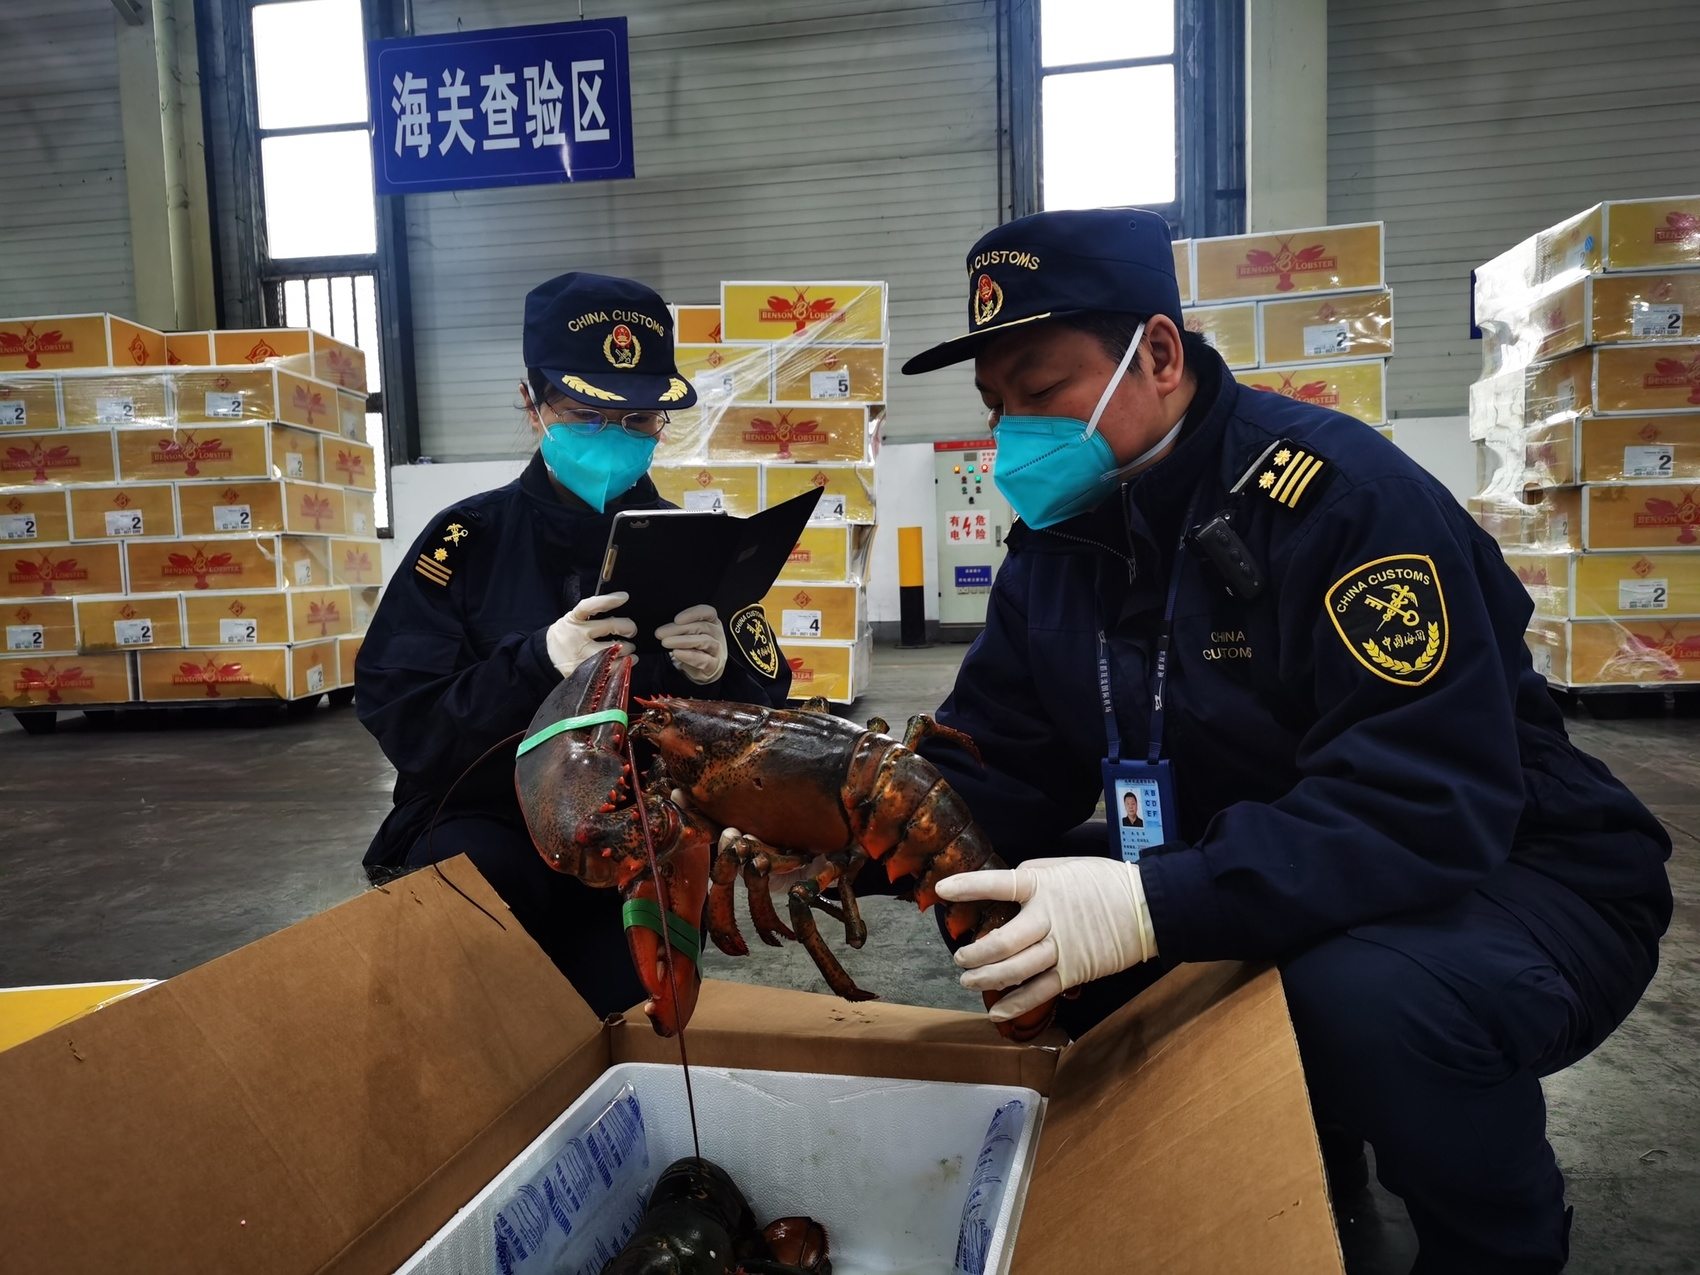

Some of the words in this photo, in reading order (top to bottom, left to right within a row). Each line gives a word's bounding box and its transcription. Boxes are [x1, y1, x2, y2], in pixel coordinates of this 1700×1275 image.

[391, 59, 610, 158] 海关查验区
[975, 251, 1040, 270] CUSTOMS
[1240, 264, 1275, 275] BENSON
[1295, 259, 1334, 270] LOBSTER
[568, 311, 609, 332] CHINA
[612, 310, 665, 337] CUSTOMS
[1668, 313, 1681, 329] 2
[1336, 332, 1347, 347] 2
[723, 378, 733, 392] 5
[838, 379, 848, 393] 5
[123, 405, 133, 417] 2
[232, 401, 241, 412] 2
[15, 408, 24, 420] 2
[745, 433, 776, 441] BENSON
[793, 433, 826, 442] LOBSTER
[1659, 455, 1671, 470] 2
[712, 498, 722, 508] 4
[833, 503, 844, 515] 4
[132, 517, 141, 529] 2
[240, 512, 250, 524] 2
[1637, 516, 1677, 524] BENSON
[25, 521, 35, 533] 2
[1336, 581, 1368, 613] CHINA
[1368, 569, 1430, 585] CUSTOMS
[1653, 587, 1665, 602] 2
[809, 619, 820, 631] 4
[32, 632, 42, 644] 2
[141, 626, 151, 638] 2
[246, 626, 255, 638] 2
[1211, 631, 1245, 642] CHINA
